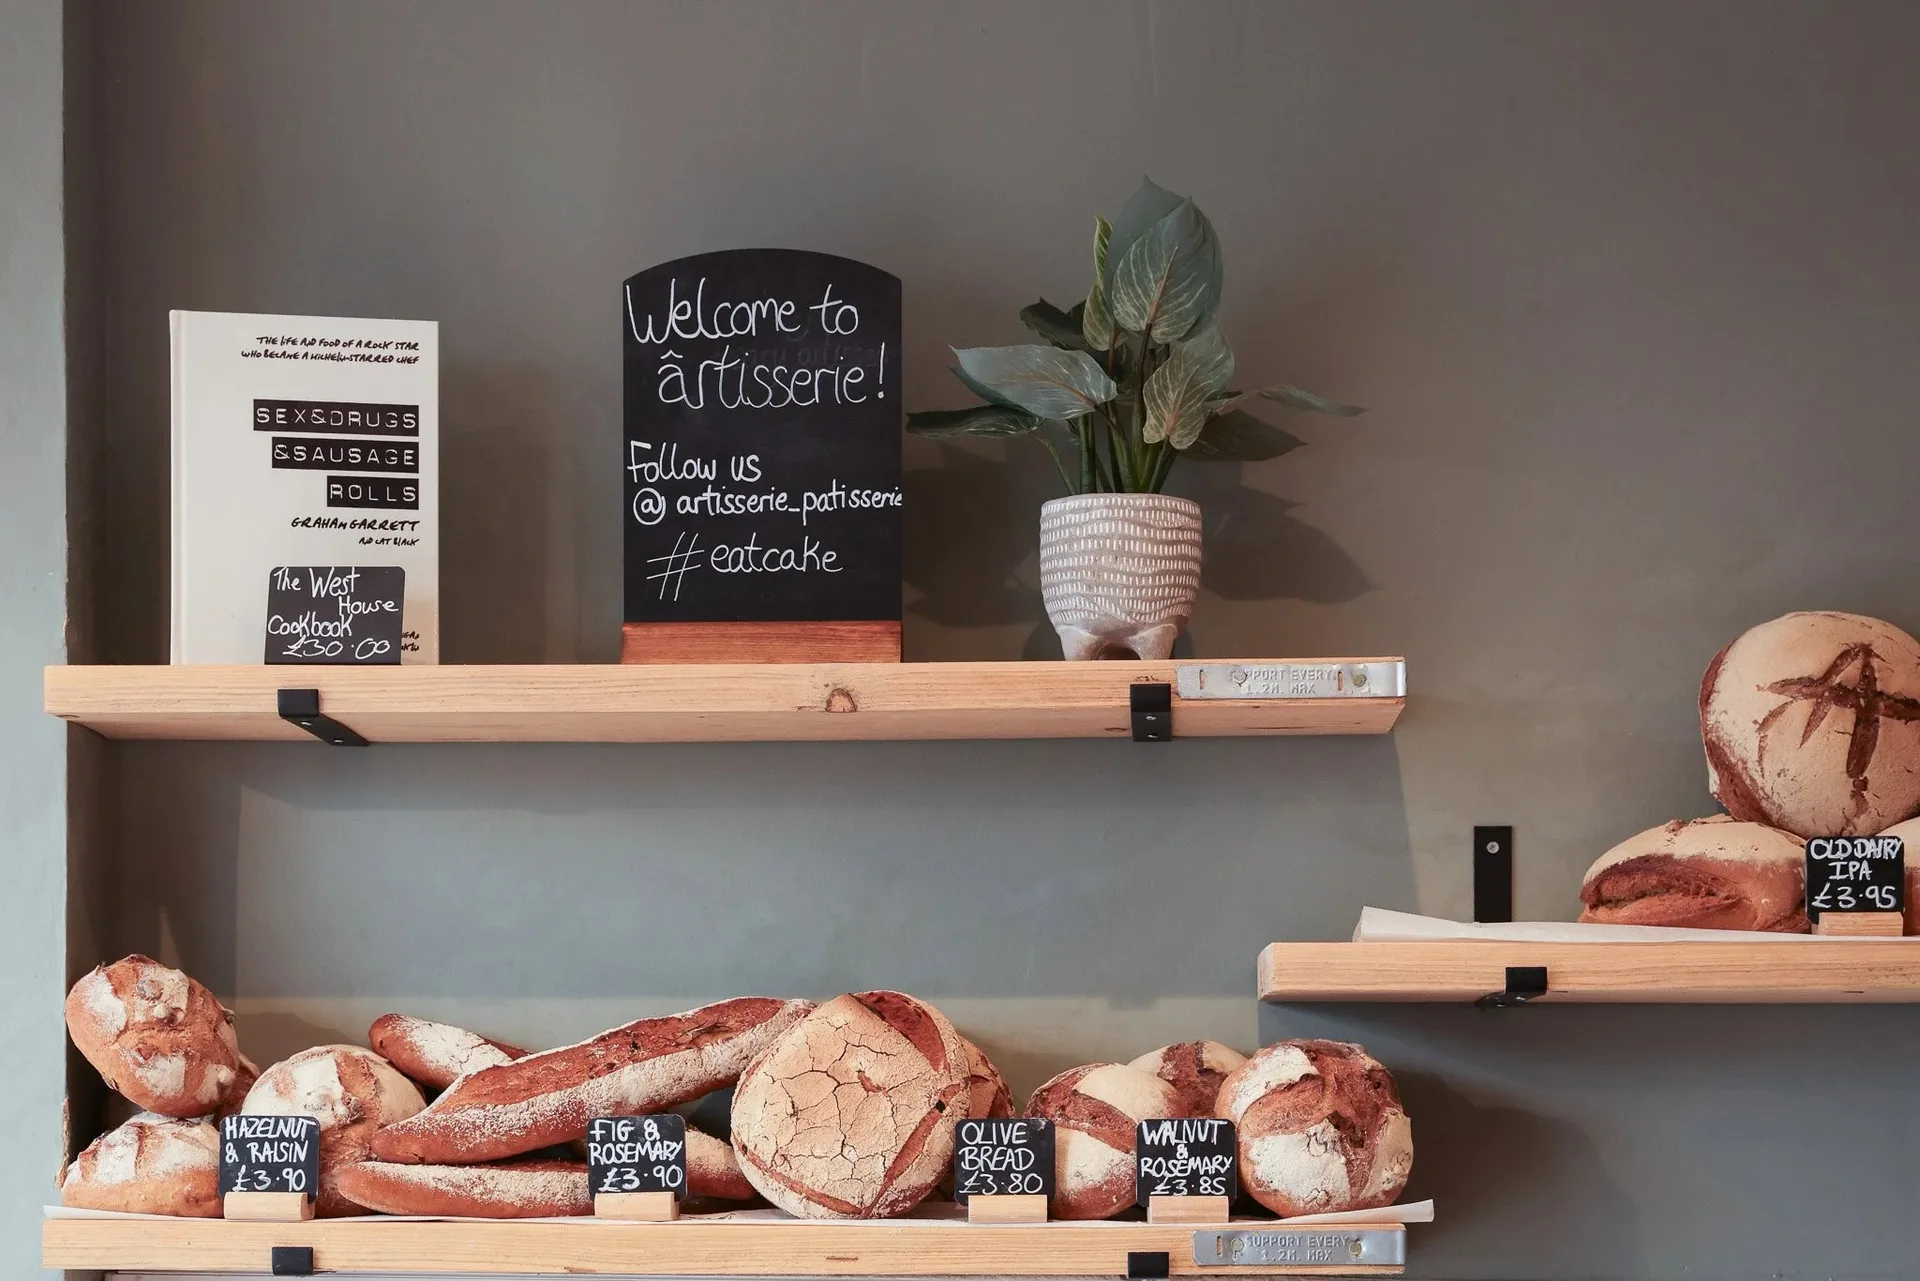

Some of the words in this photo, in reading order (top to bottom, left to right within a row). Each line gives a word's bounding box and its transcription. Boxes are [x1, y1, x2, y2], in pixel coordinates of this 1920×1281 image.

[626, 277, 802, 344] Welcome
[808, 283, 860, 335] to
[256, 336, 278, 345] THE
[300, 337, 317, 347] AND
[319, 338, 341, 347] FOOD
[342, 339, 354, 348] OF
[355, 339, 363, 348] A
[364, 340, 393, 349] ROCK
[395, 341, 419, 351] STAR
[241, 349, 262, 358] WHO
[263, 348, 300, 360] BECAME
[301, 351, 309, 360] A
[396, 355, 419, 364] CHEF
[256, 407, 417, 429] SEX&DRUGS
[273, 443, 416, 466] &SAUSAGE
[627, 440, 717, 483] Follow
[730, 454, 762, 482] us
[329, 483, 417, 502] ROLLS
[349, 518, 420, 531] GARRETT
[375, 536, 392, 546] CAT
[273, 566, 302, 591] The
[308, 566, 361, 598] West
[338, 595, 399, 616] House
[267, 611, 353, 637] Cookbook
[282, 635, 391, 660] £30.00
[1291, 683, 1316, 694] MAX
[1810, 838, 1853, 860] OLD
[1853, 837, 1903, 860] DAIRY
[1828, 859, 1873, 881] IPA
[1811, 881, 1897, 909] £3.95
[225, 1116, 317, 1141] HAZELNUT
[589, 1119, 635, 1141] FIG
[643, 1119, 660, 1141] &
[961, 1122, 1028, 1145] OLIVE
[1142, 1119, 1228, 1146] WALNUT
[225, 1142, 239, 1163] &
[246, 1140, 309, 1163] RAISIN
[588, 1140, 683, 1166] ROSEMARY
[958, 1145, 1035, 1172] BREAD
[1176, 1143, 1189, 1160] &
[1140, 1154, 1233, 1178] ROSEMARY
[232, 1164, 306, 1192] £3.90
[598, 1164, 683, 1192] £3.90
[958, 1170, 1043, 1196] £3.80
[1150, 1173, 1226, 1196] £3.85
[1245, 1235, 1302, 1247] SUPPORT
[1307, 1249, 1333, 1261] MAX
